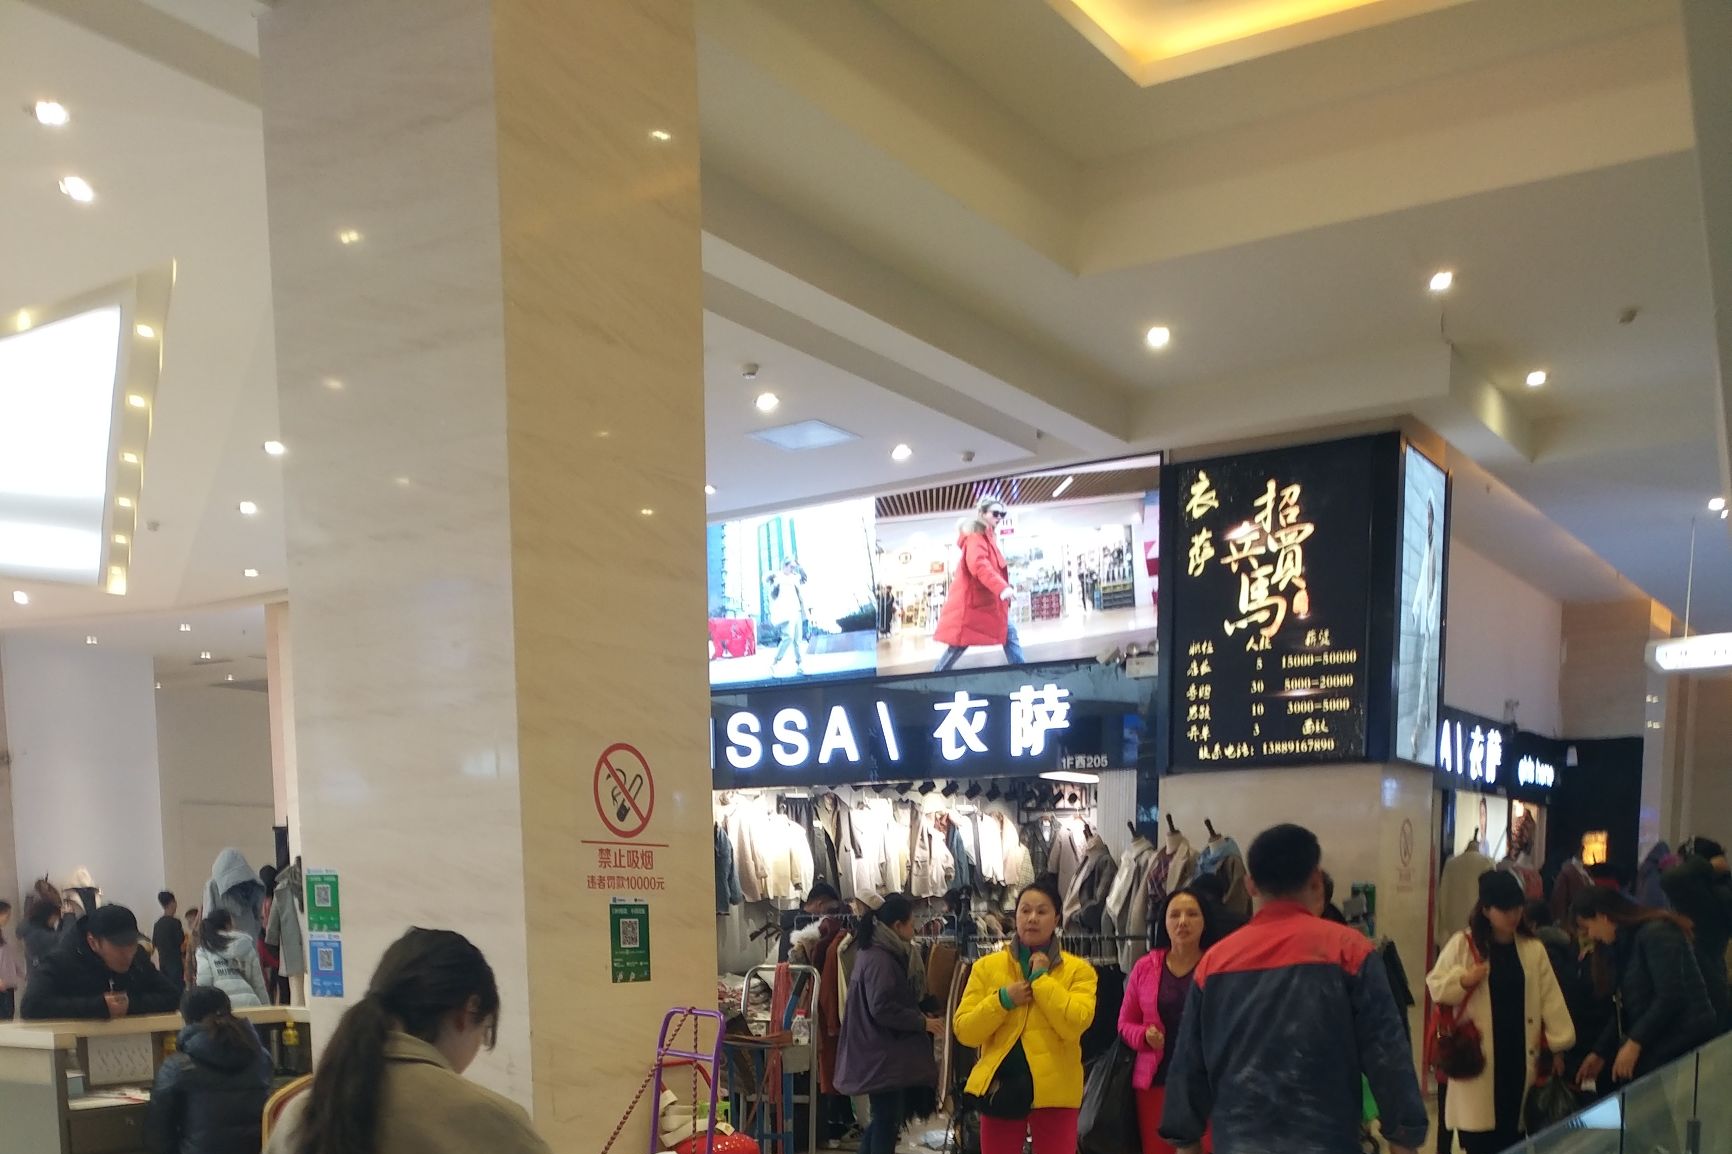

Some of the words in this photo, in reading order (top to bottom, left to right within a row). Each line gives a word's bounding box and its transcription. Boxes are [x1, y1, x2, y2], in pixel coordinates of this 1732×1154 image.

[1250, 680, 1265, 694] 30
[1252, 703, 1265, 716] 10
[933, 683, 1071, 761] 衣萨
[598, 847, 654, 870] 禁止吸烟
[586, 874, 665, 890] 违者罚款10000元
